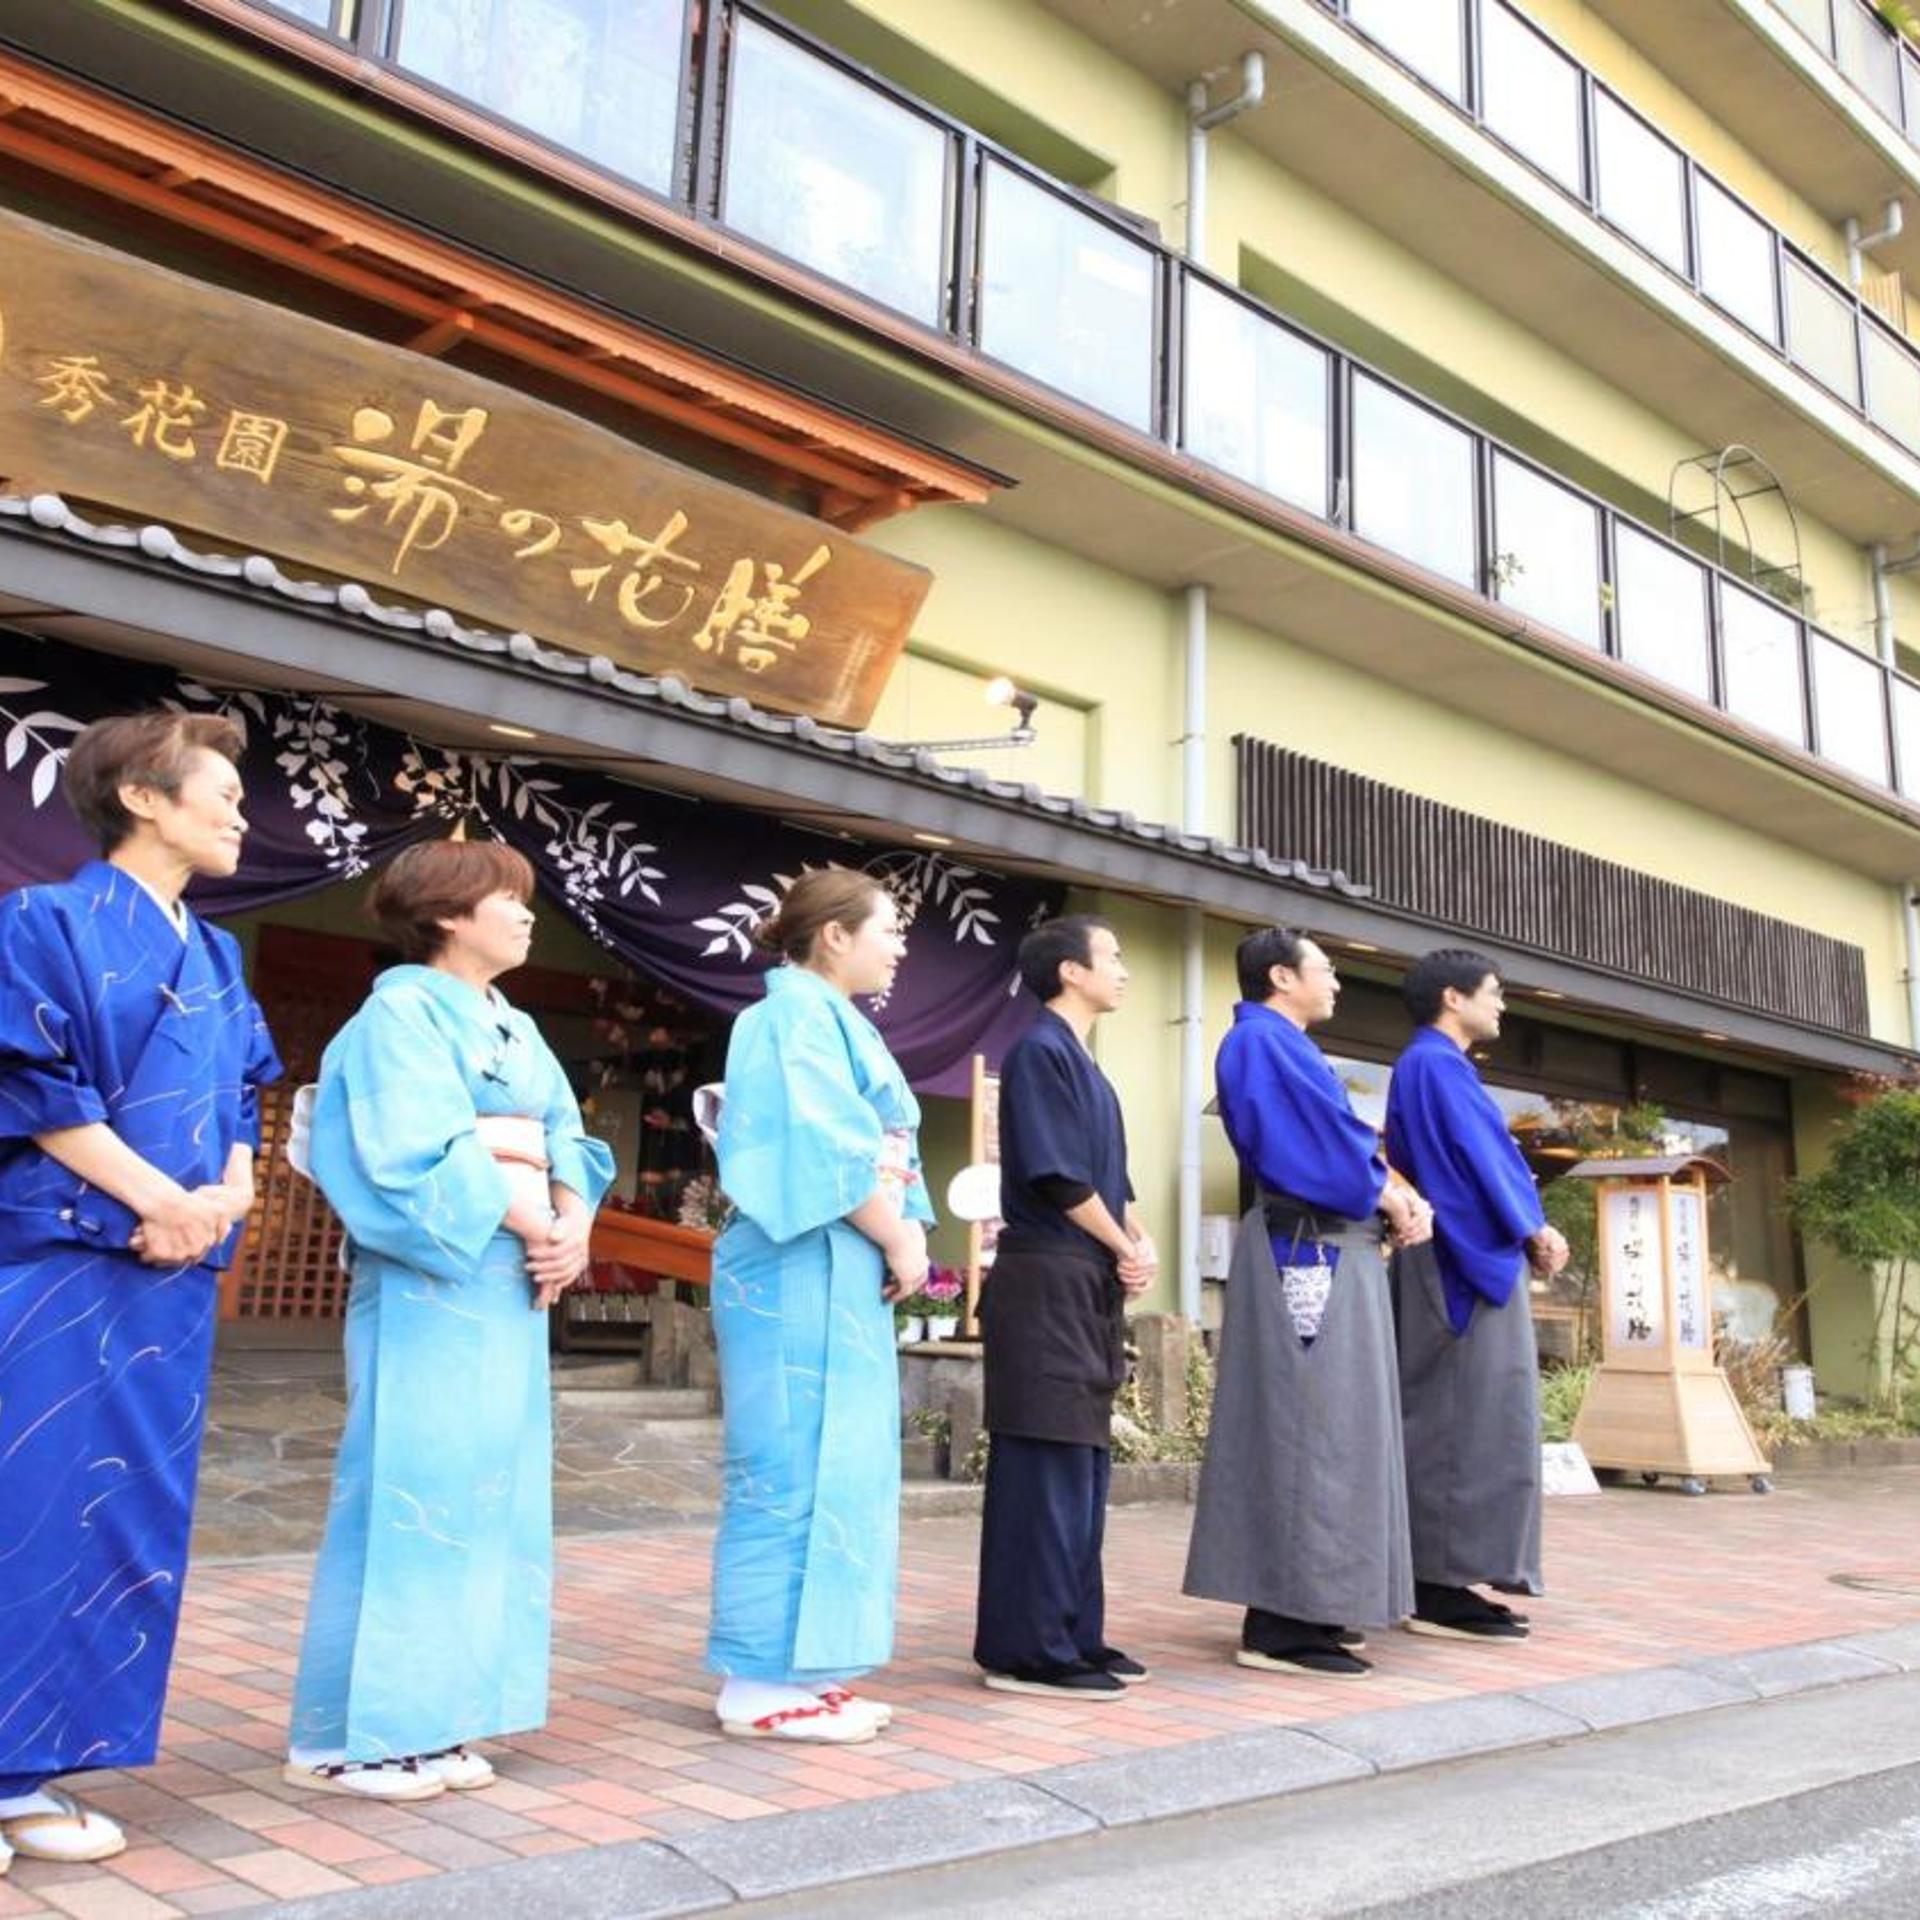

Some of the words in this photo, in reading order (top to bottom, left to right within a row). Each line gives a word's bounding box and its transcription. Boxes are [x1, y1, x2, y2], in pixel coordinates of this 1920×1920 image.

[36, 355, 290, 484] 秀花園
[330, 398, 832, 673] 湯の花膳
